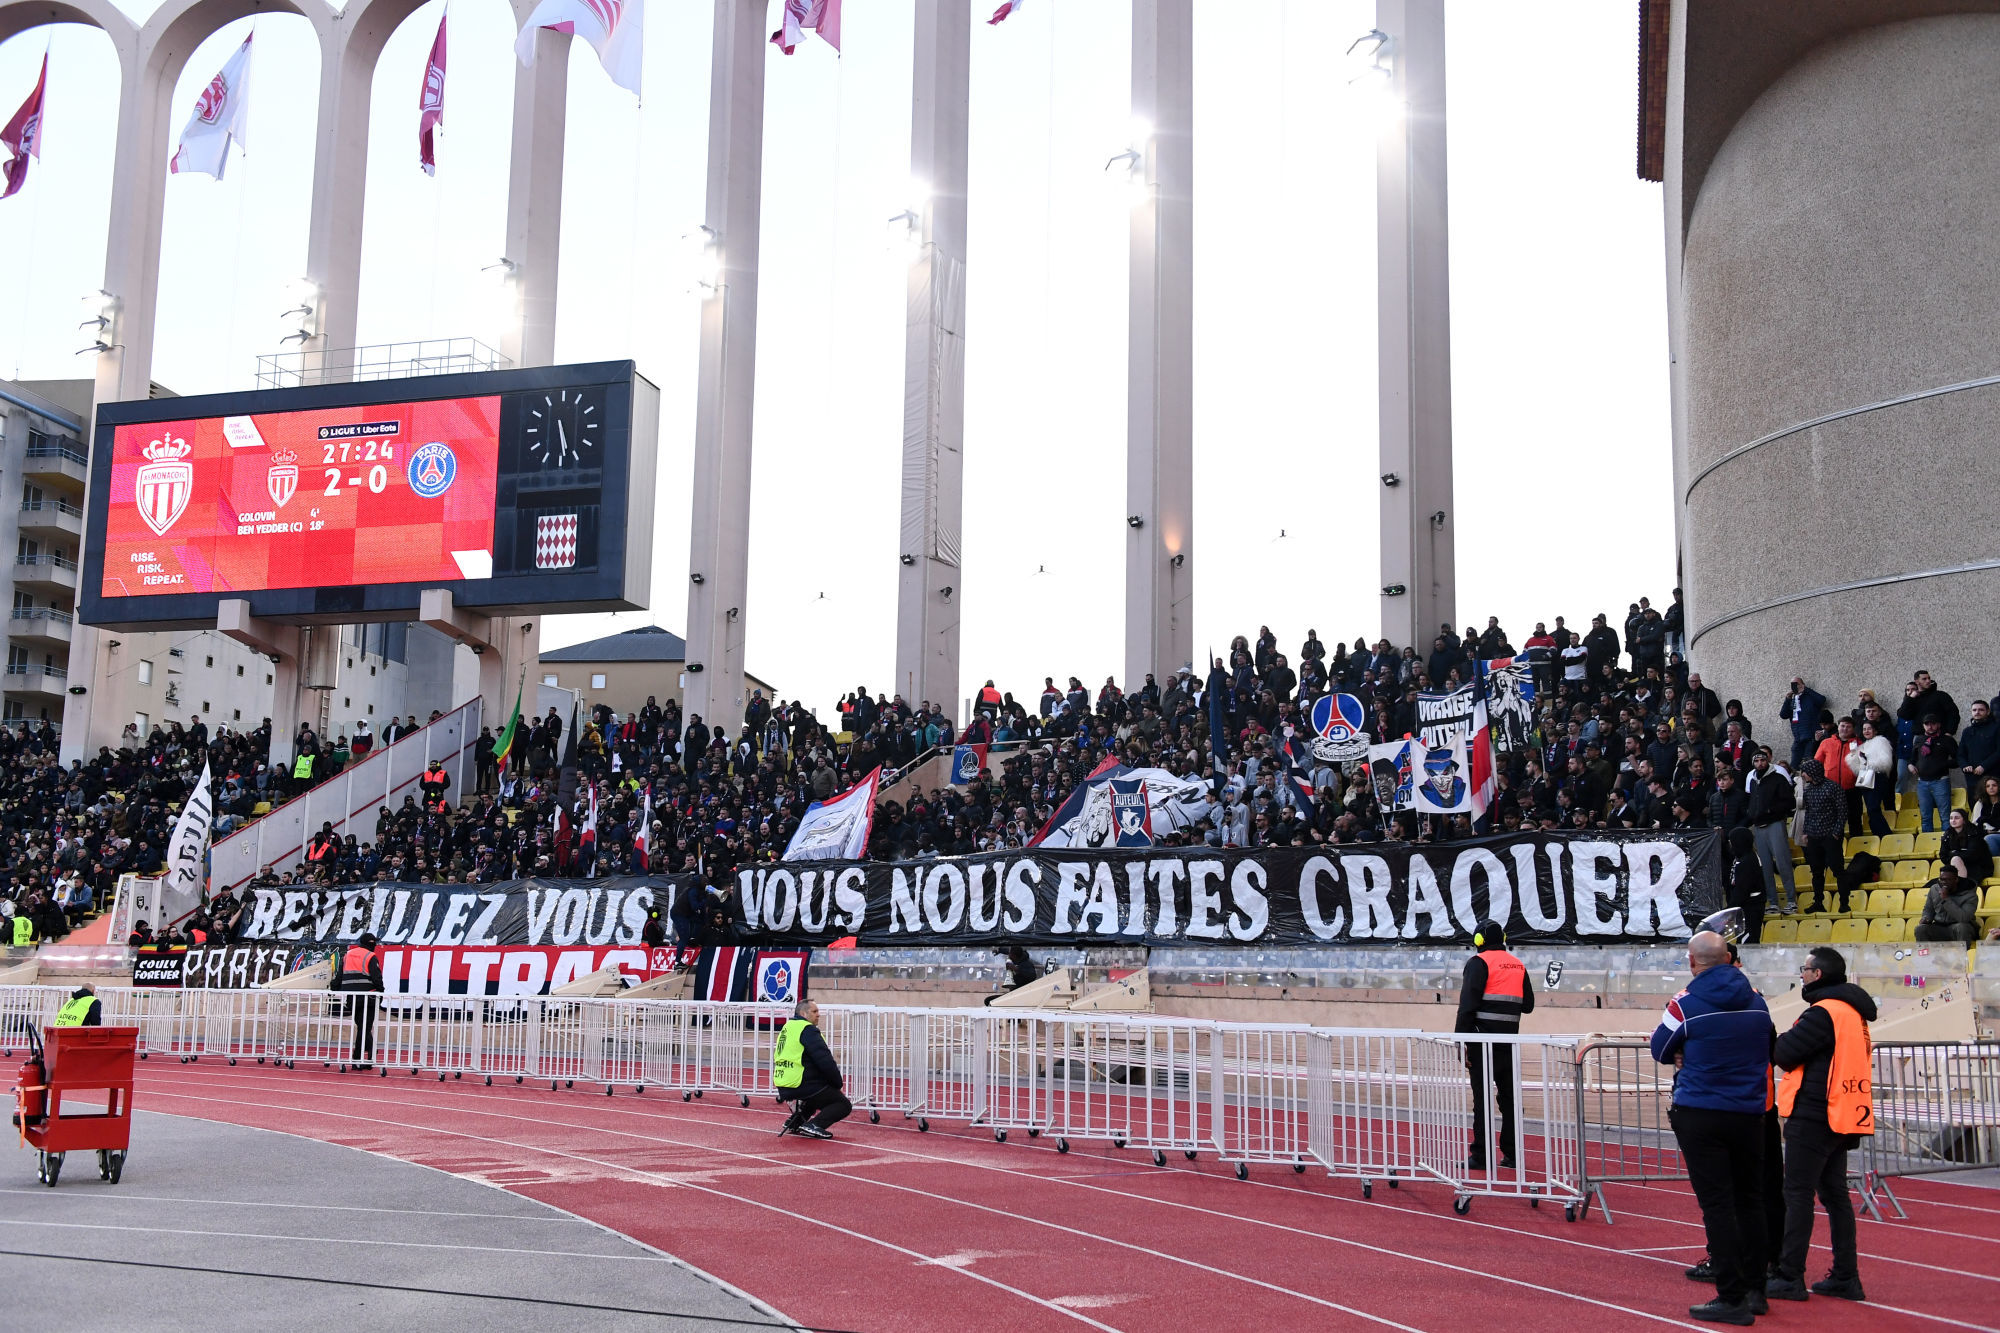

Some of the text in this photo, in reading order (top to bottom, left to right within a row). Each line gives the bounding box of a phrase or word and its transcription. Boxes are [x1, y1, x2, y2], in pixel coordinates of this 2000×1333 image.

[330, 427, 355, 436] LIGUE
[322, 440, 393, 464] 27:24
[417, 446, 449, 460] PARIS
[150, 471, 180, 481] MONACO
[238, 511, 276, 523] GOLOVIN
[237, 525, 254, 535] BEN
[256, 523, 289, 534] YEDDER
[290, 522, 303, 533] (C)
[130, 552, 157, 562] RISE.
[137, 564, 165, 574] RISK.
[143, 574, 184, 585] REPEAT.
[1418, 691, 1474, 722] VIRAGE
[1115, 793, 1144, 806] AUTEUIL
[738, 867, 867, 933] VOUS
[889, 858, 1041, 933] NOUS
[1050, 858, 1269, 941] FAITES
[244, 888, 508, 947] REVEILLEZ
[527, 886, 655, 946] VOUS
[139, 959, 177, 969] COULY
[183, 948, 290, 988] PARIS
[134, 970, 180, 980] FOREVER
[1855, 1105, 1871, 1127] 2
